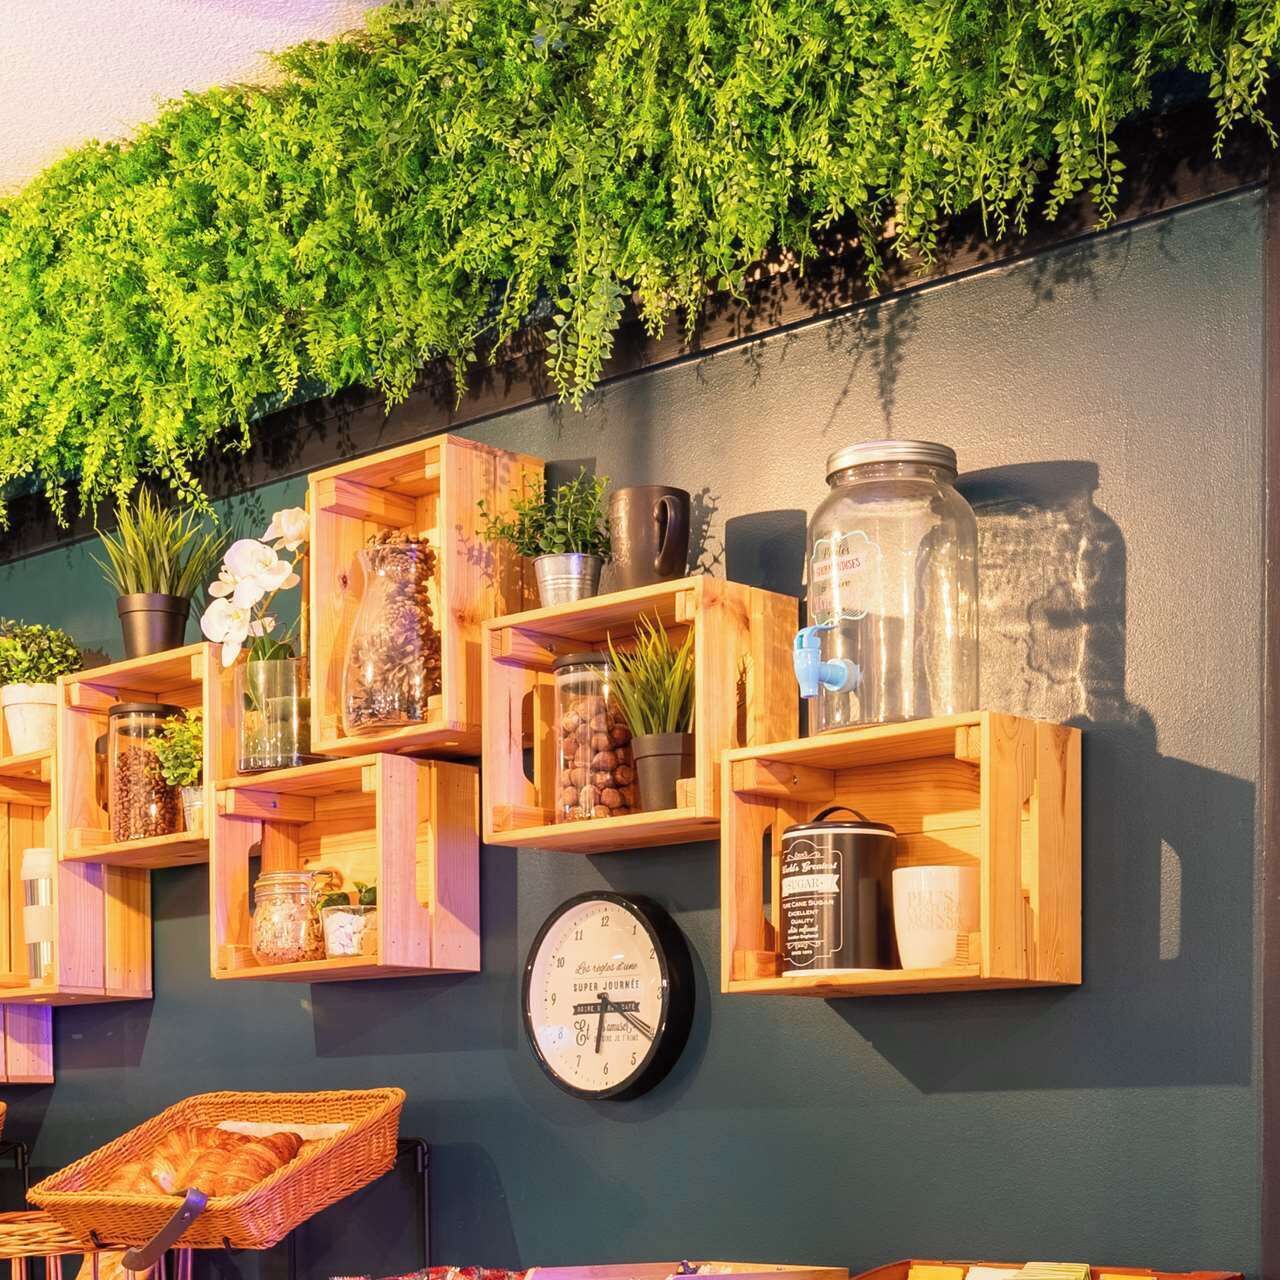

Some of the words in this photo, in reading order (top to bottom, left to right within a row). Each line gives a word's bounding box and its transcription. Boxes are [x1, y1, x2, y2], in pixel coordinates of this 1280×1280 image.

[601, 916, 609, 927] 12
[575, 930, 583, 941] 11
[556, 957, 565, 968] 10
[573, 982, 598, 992] SUPER
[602, 978, 640, 990] JOURNÉE
[603, 1062, 608, 1075] 6
